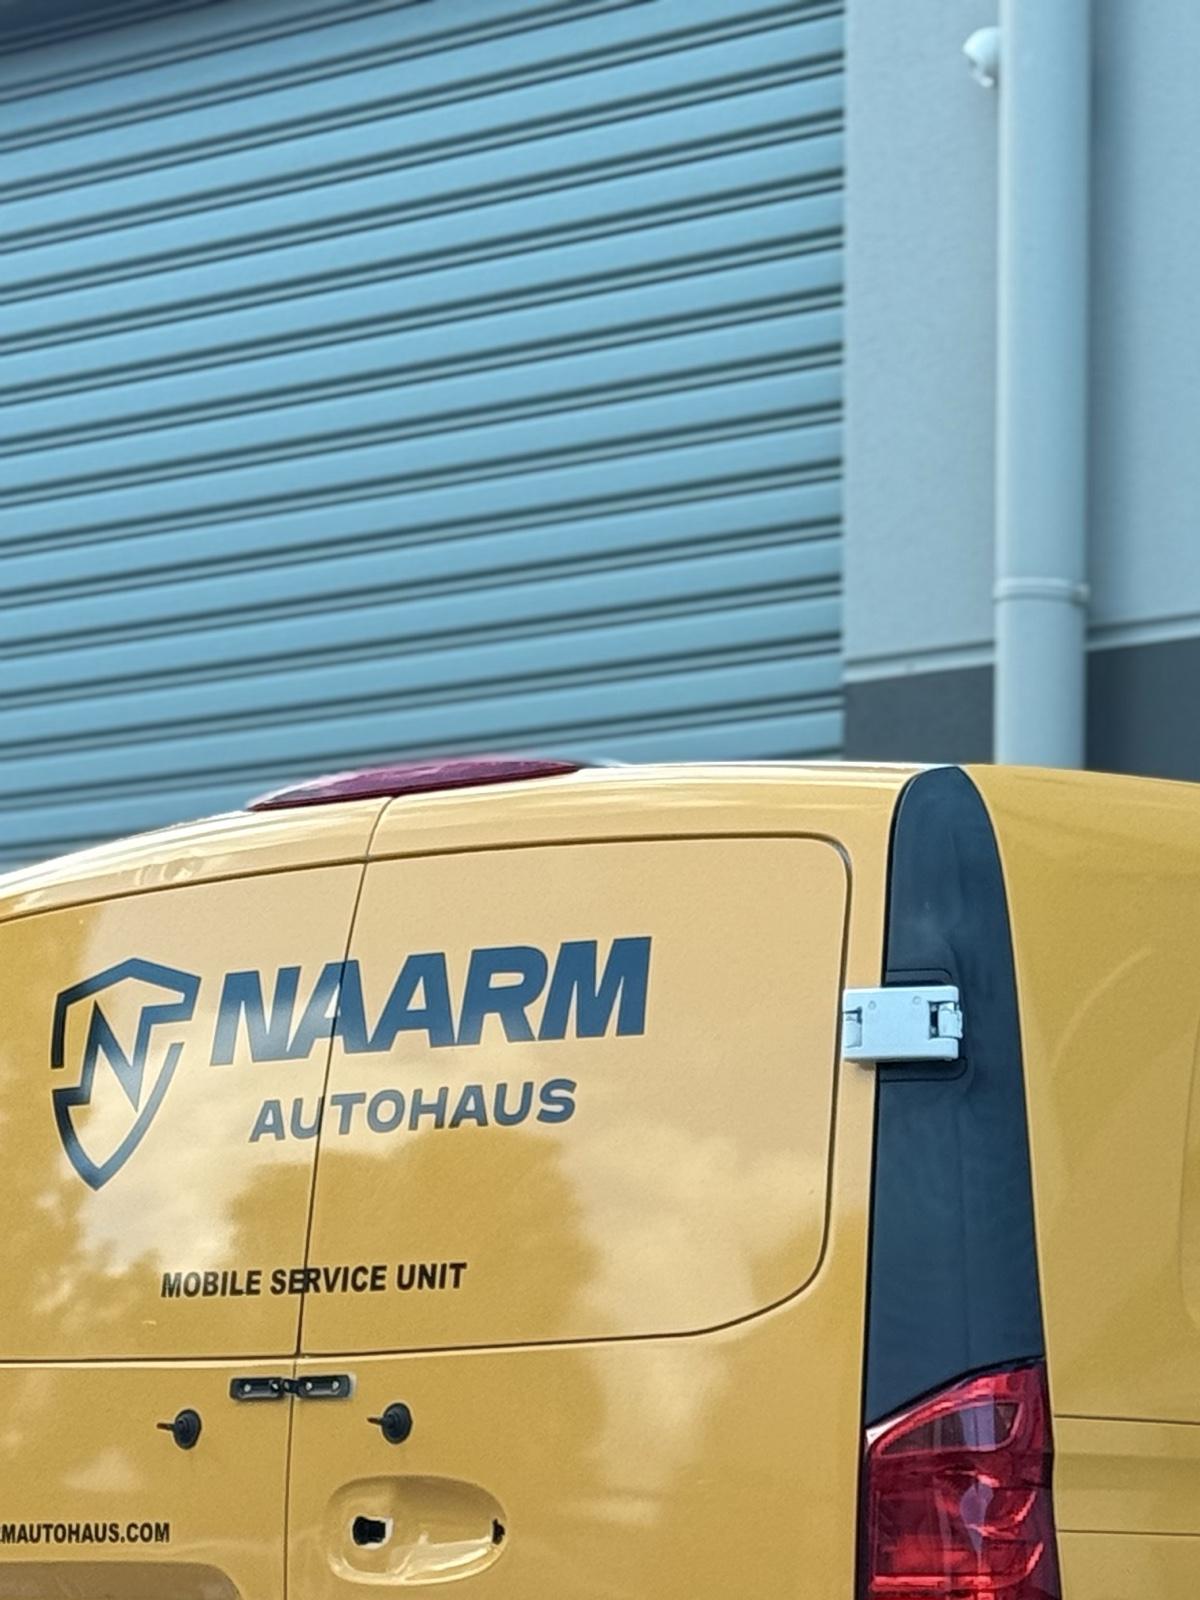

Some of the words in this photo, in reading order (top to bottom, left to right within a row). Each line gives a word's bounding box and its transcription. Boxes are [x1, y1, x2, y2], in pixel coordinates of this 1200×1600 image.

[210, 936, 652, 1066] NAARM
[248, 1079, 577, 1143] AUTOHAUS
[160, 1270, 262, 1298] MOBILE
[270, 1265, 387, 1295] SERVICE
[395, 1263, 467, 1290] UNIT
[0, 1521, 170, 1544] MAUTOHAUS.COM
